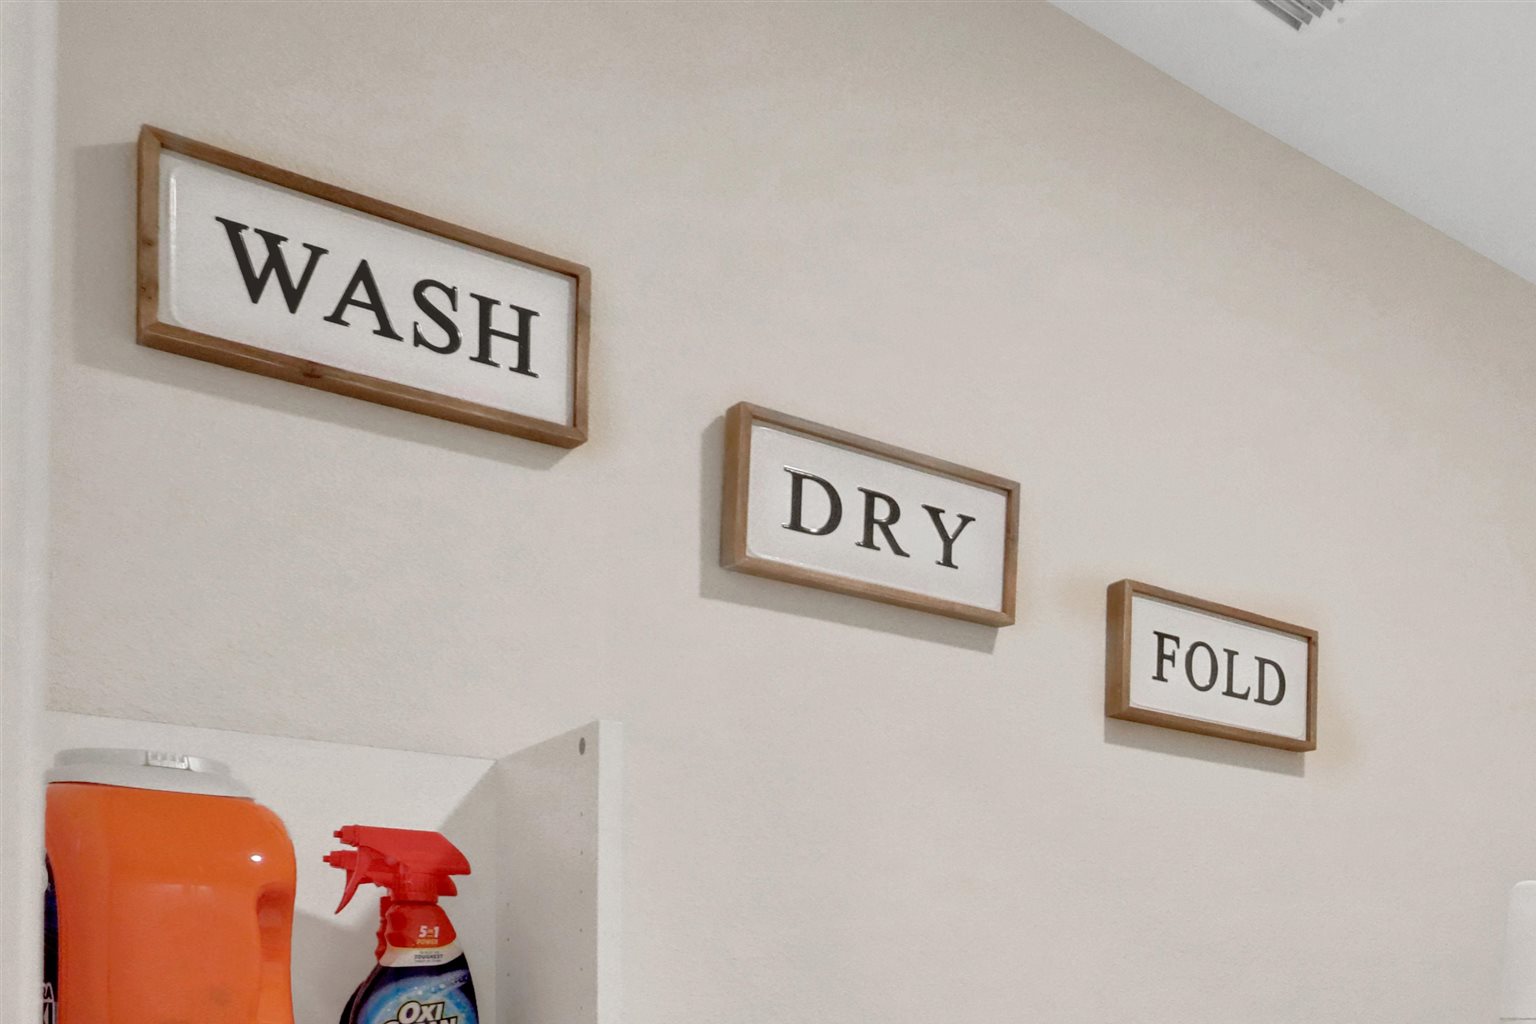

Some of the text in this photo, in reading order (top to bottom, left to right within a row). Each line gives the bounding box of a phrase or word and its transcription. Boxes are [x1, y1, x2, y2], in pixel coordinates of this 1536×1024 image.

[215, 215, 541, 379] WASH
[780, 464, 977, 570] DRY
[1150, 630, 1288, 707] FOLD
[397, 1000, 445, 1024] OXI
